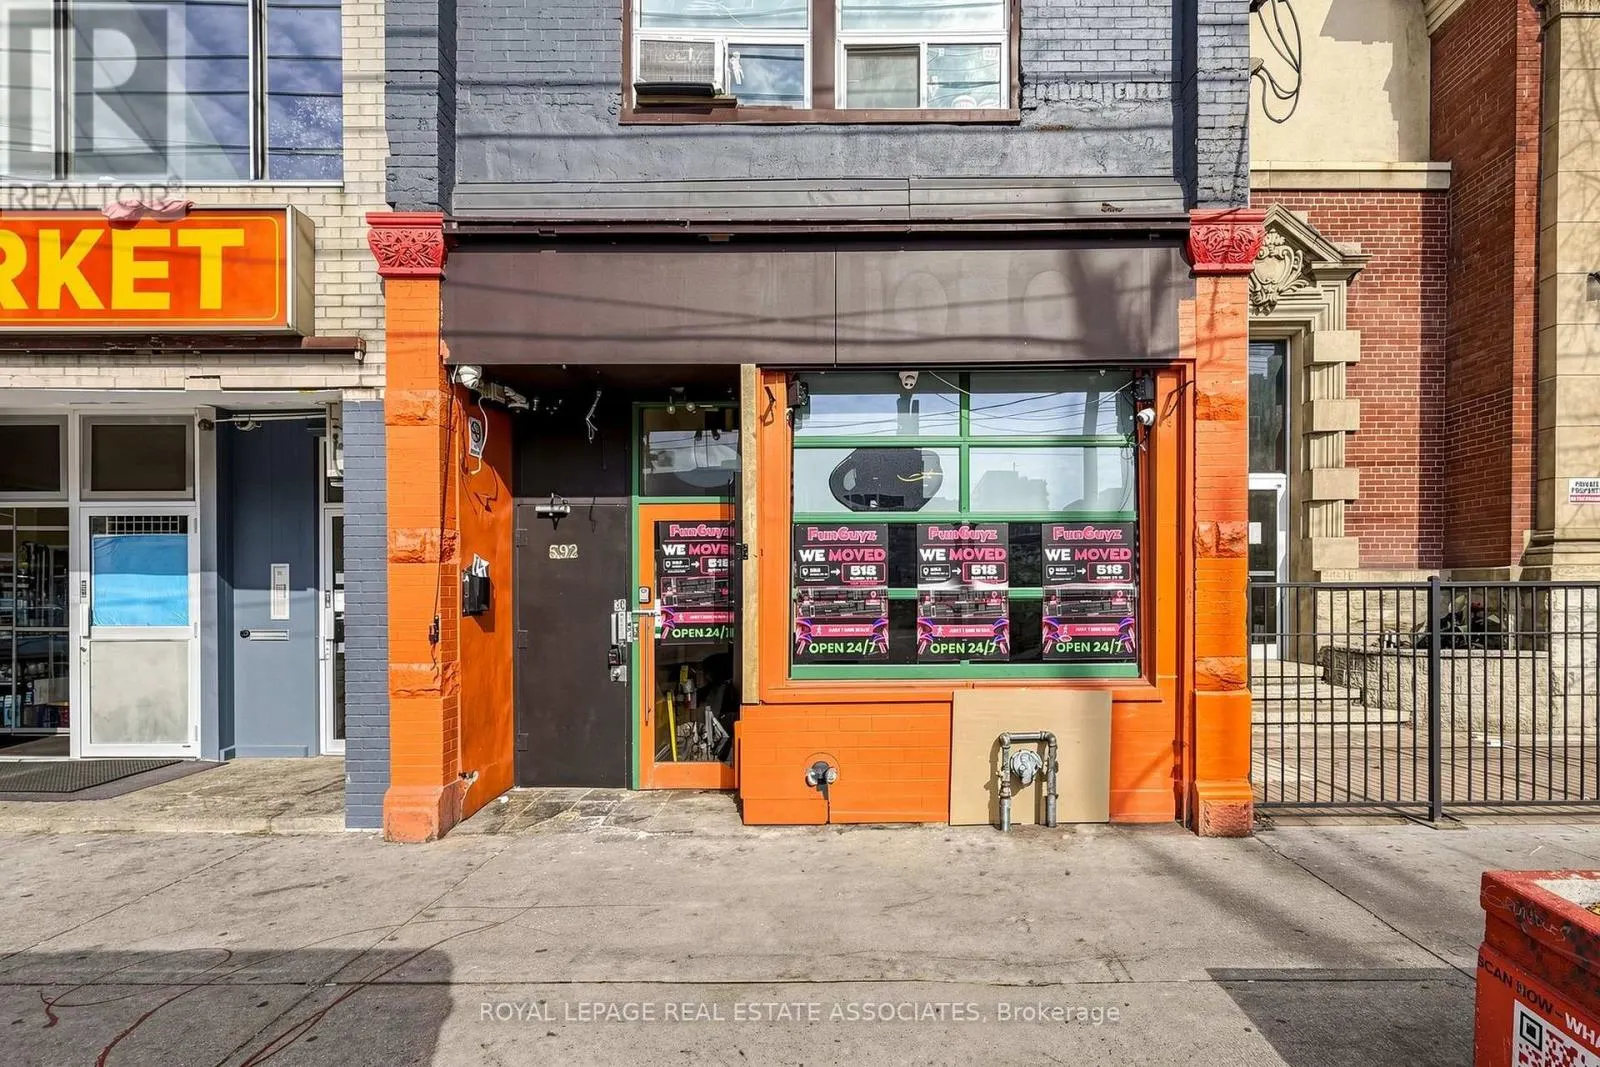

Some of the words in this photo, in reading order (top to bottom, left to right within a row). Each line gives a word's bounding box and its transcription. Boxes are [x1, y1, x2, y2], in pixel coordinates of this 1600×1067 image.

[807, 527, 878, 543] FunGuyz
[928, 526, 998, 543] FunGuyz
[1052, 526, 1123, 543] FunGuyz
[662, 544, 686, 556] WE
[688, 544, 729, 555] MOVE
[799, 549, 826, 562] WE
[828, 548, 886, 562] MOVED
[919, 548, 946, 561] WE
[949, 548, 1006, 561] MOVED
[1044, 548, 1071, 561] WE
[1074, 548, 1132, 561] MOVED
[672, 628, 703, 638] OPEN
[808, 642, 845, 653] OPEN
[846, 639, 876, 655] 24/7
[930, 643, 965, 654] OPEN
[968, 640, 997, 656] 24/7
[1056, 642, 1091, 652] OPEN
[1093, 638, 1122, 654] 24/7
[1478, 955, 1513, 988] SCAN
